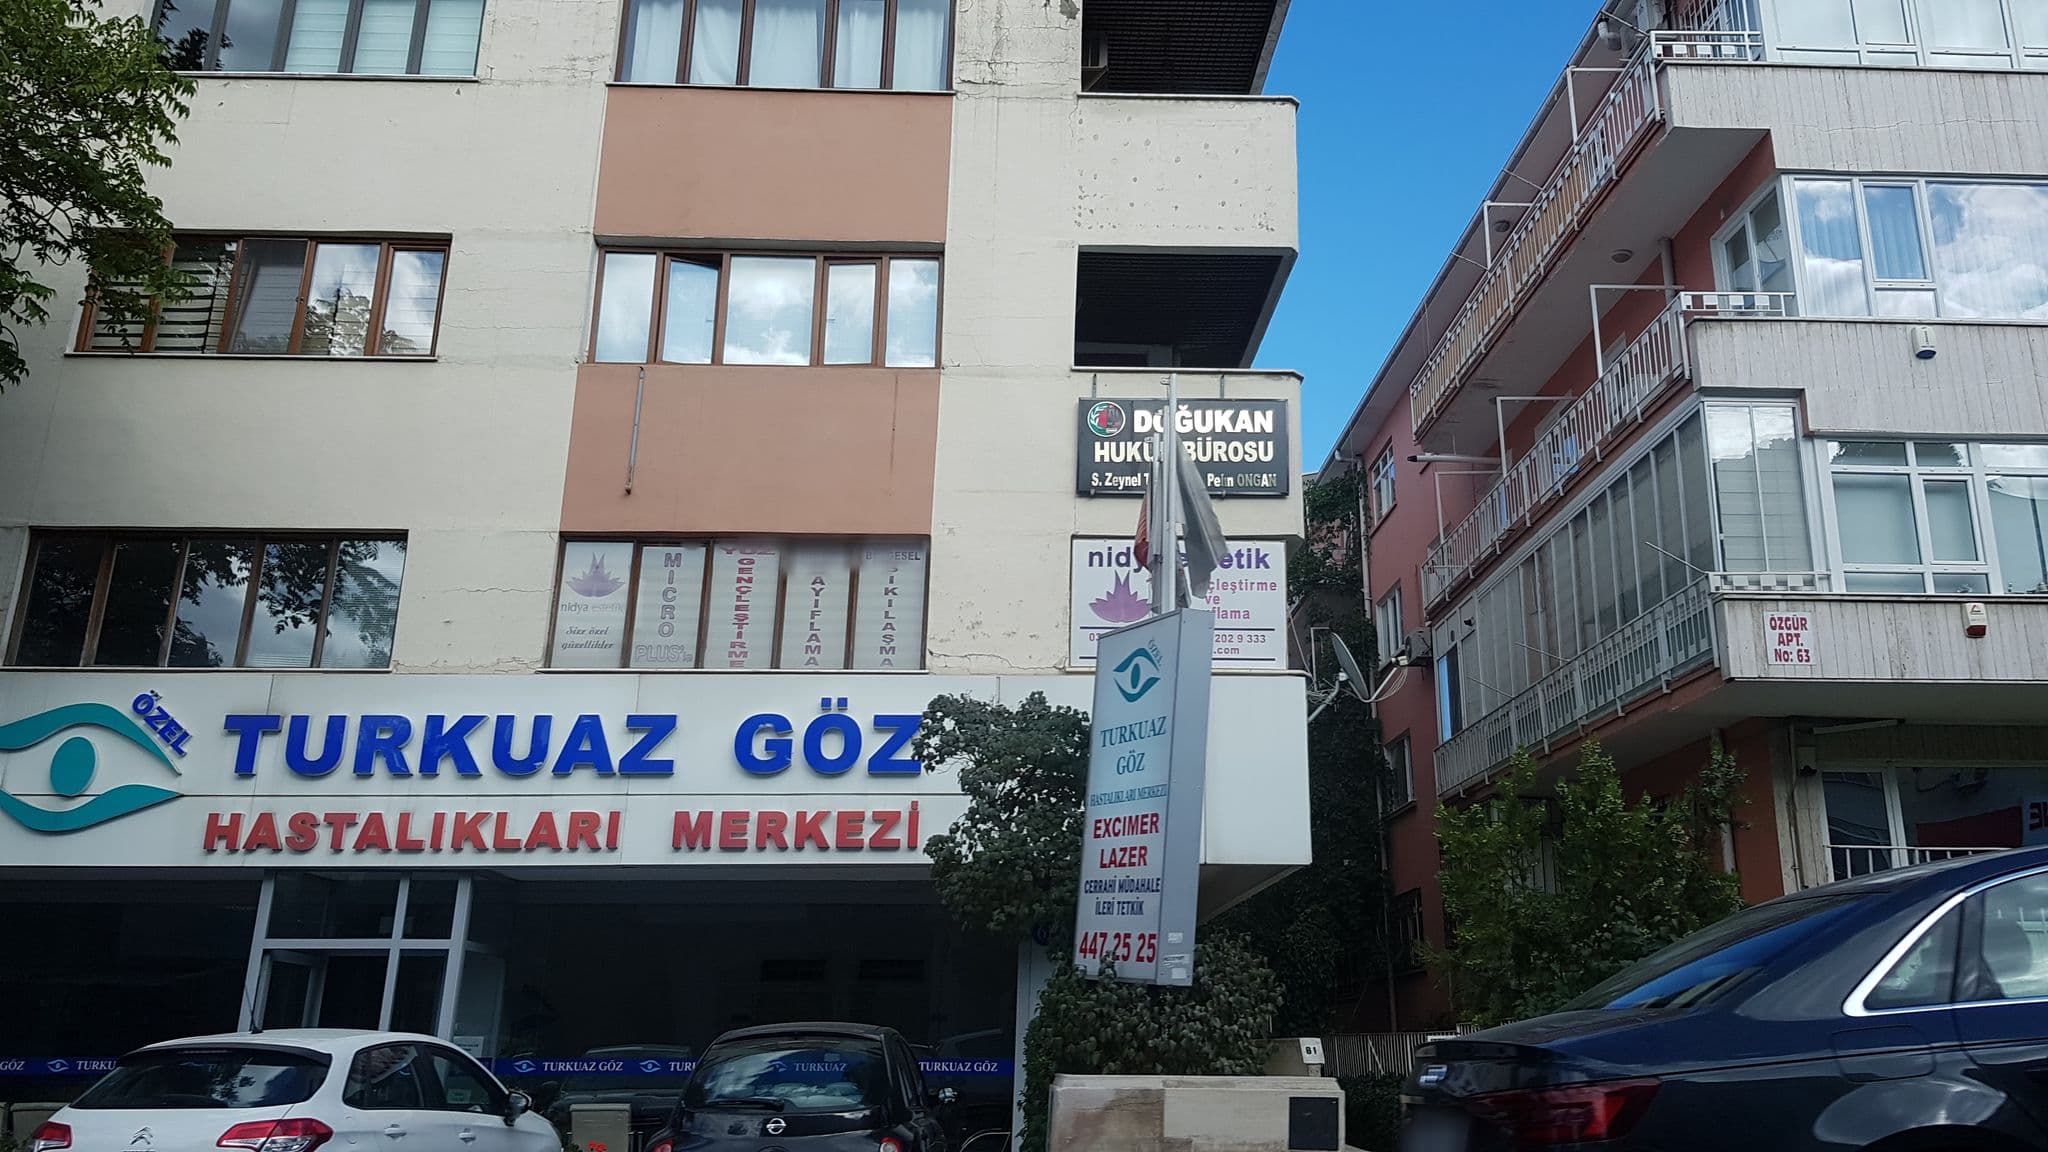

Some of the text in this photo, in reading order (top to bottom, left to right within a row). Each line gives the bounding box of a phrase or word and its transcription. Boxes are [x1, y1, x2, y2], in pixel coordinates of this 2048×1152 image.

[1094, 441, 1163, 463] HUKU
[1091, 473, 1102, 486] S.
[1105, 473, 1141, 490] Zeynel
[1088, 546, 1142, 573] nid
[1208, 579, 1277, 594] çleştirme
[804, 576, 826, 666] AYIFLAMA
[1769, 614, 1808, 631] ÖZGÜR
[1215, 634, 1234, 643] 202
[1237, 634, 1244, 643] 9
[1246, 634, 1266, 643] 333
[1777, 633, 1804, 647] APT.
[1213, 647, 1240, 655] .com
[1796, 648, 1811, 662] 63
[131, 689, 193, 759] ÖZEL
[1100, 716, 1168, 748] TURKUAZ
[224, 697, 923, 777] TURKUAZ GÖZ
[1116, 750, 1145, 775] GÖZ
[203, 800, 920, 852] HASTALIKLARI MERKEZİ
[1093, 812, 1160, 839] EXCIMER
[1099, 846, 1148, 869] LAZER
[1084, 875, 1161, 894] CERRAHİ MÜDAHALE
[1116, 897, 1144, 916] TETKİK
[1079, 932, 1157, 963] 447 25 25
[76, 1060, 117, 1071] TURKU
[543, 1060, 624, 1072] TURKUAZ GÖZ
[794, 1062, 847, 1073] TURKUAZ
[918, 1060, 998, 1072] TURKUAZ GÖZ
